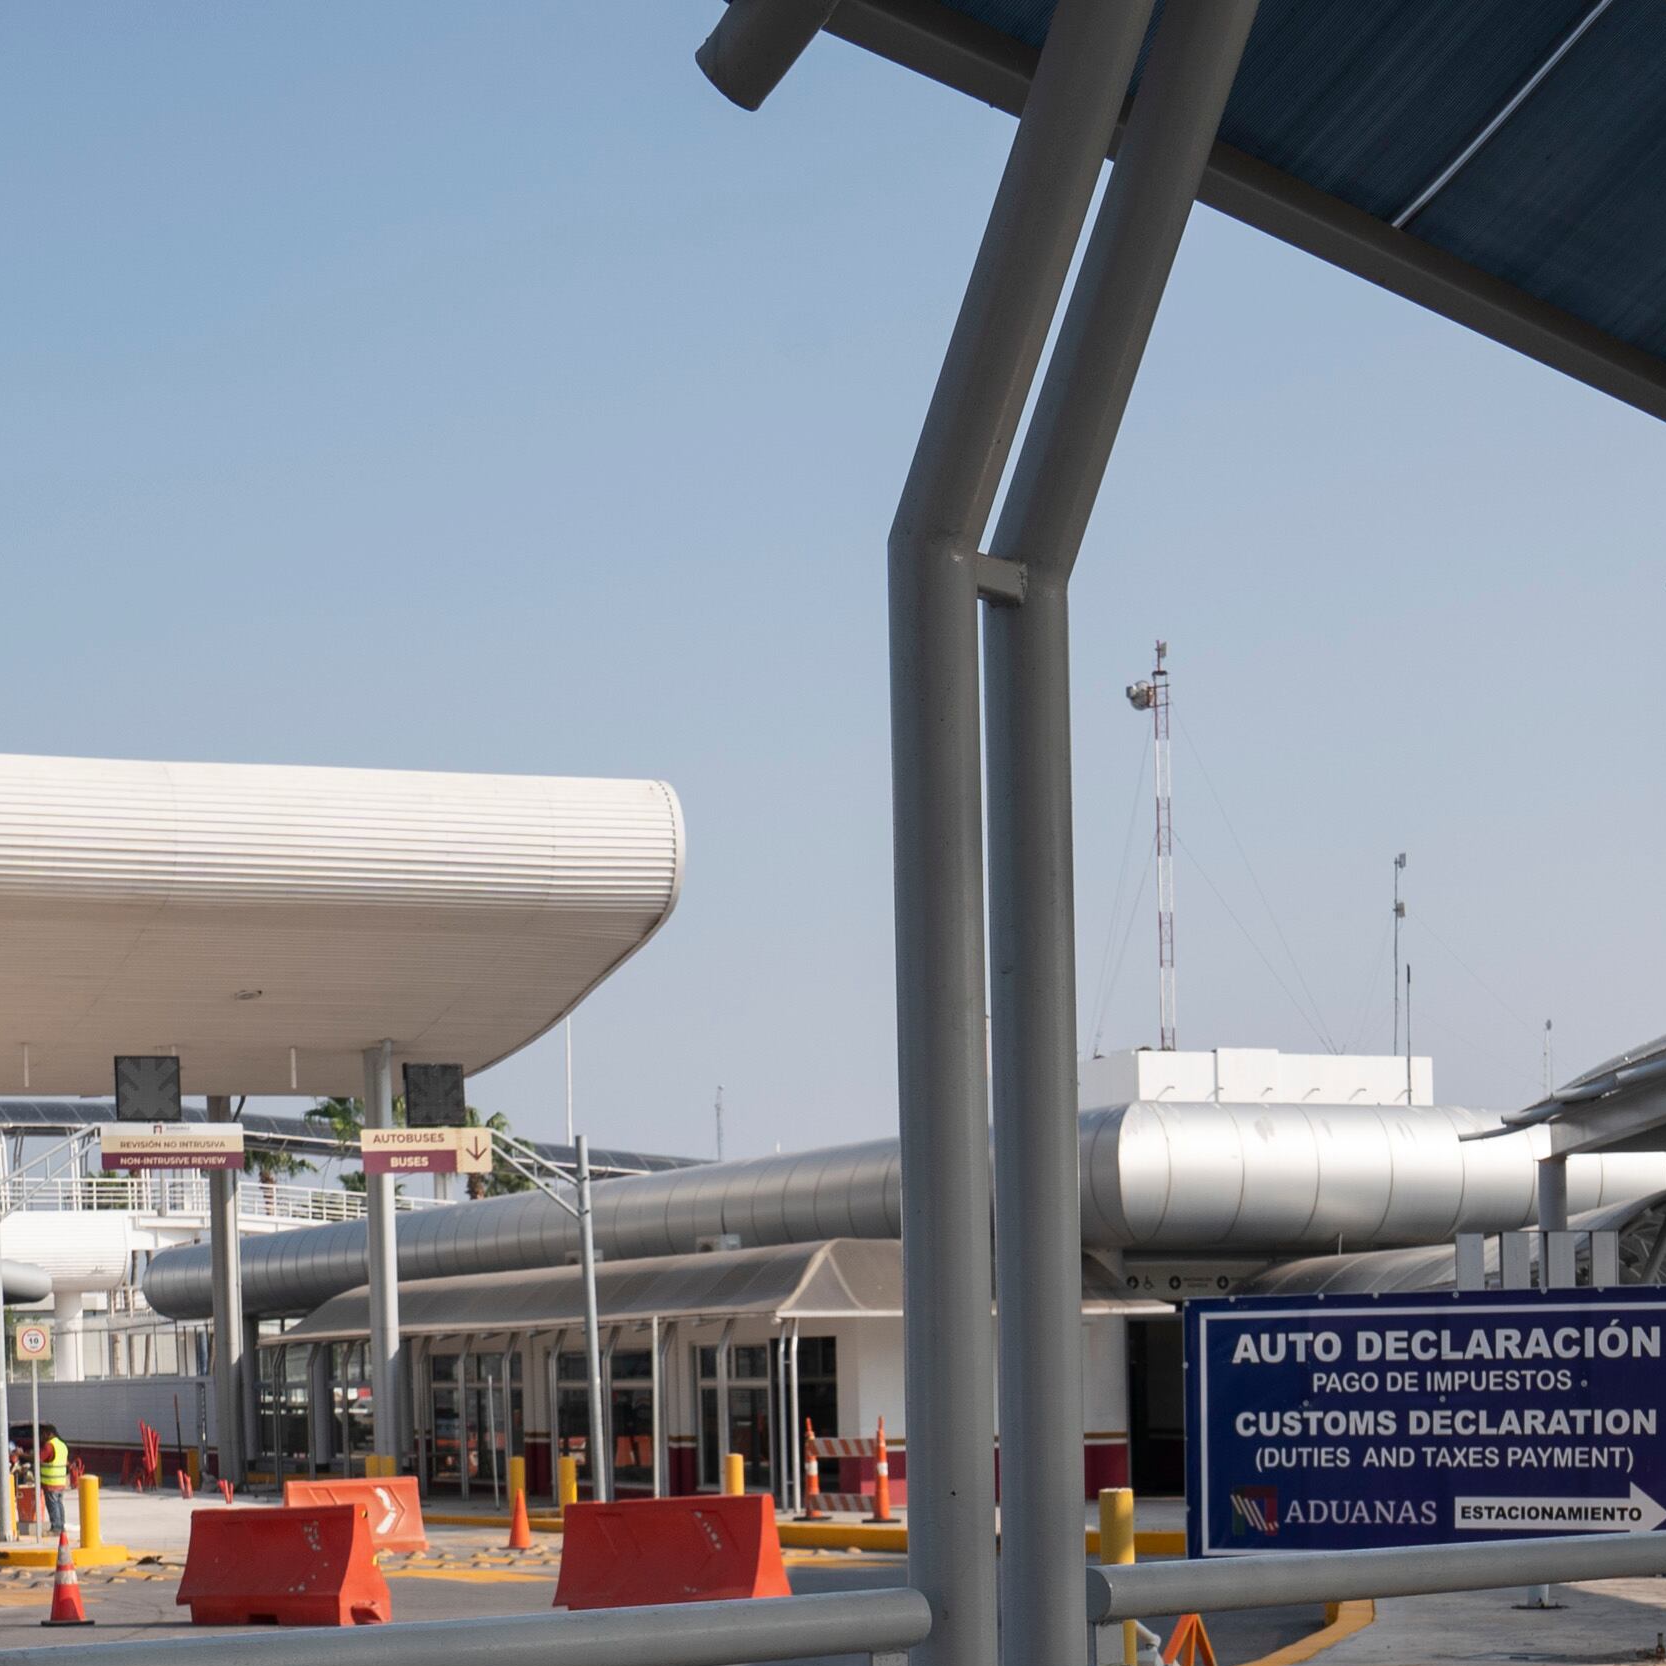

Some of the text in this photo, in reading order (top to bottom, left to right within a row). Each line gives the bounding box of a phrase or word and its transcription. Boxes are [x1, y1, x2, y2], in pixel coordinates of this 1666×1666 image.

[120, 1139, 226, 1149] REVISIÓN NO INTRUSIVA
[373, 1132, 445, 1144] AUTOBUSES
[120, 1155, 227, 1166] NON-INTRUSIVE REVIEW
[390, 1156, 430, 1168] BUSES
[29, 1336, 39, 1345] 10
[1232, 1318, 1661, 1364] AUTO DECLARACIÓN
[1312, 1369, 1573, 1394] PAGO DE IMPUESTOS
[1234, 1408, 1658, 1438] CUSTOMS DECLARATION
[1254, 1446, 1635, 1473] (DUTIES AND TAXES PAYMENT)
[1284, 1499, 1438, 1525] ADUANAS
[1460, 1505, 1643, 1522] ESTACIONAMIENTO
